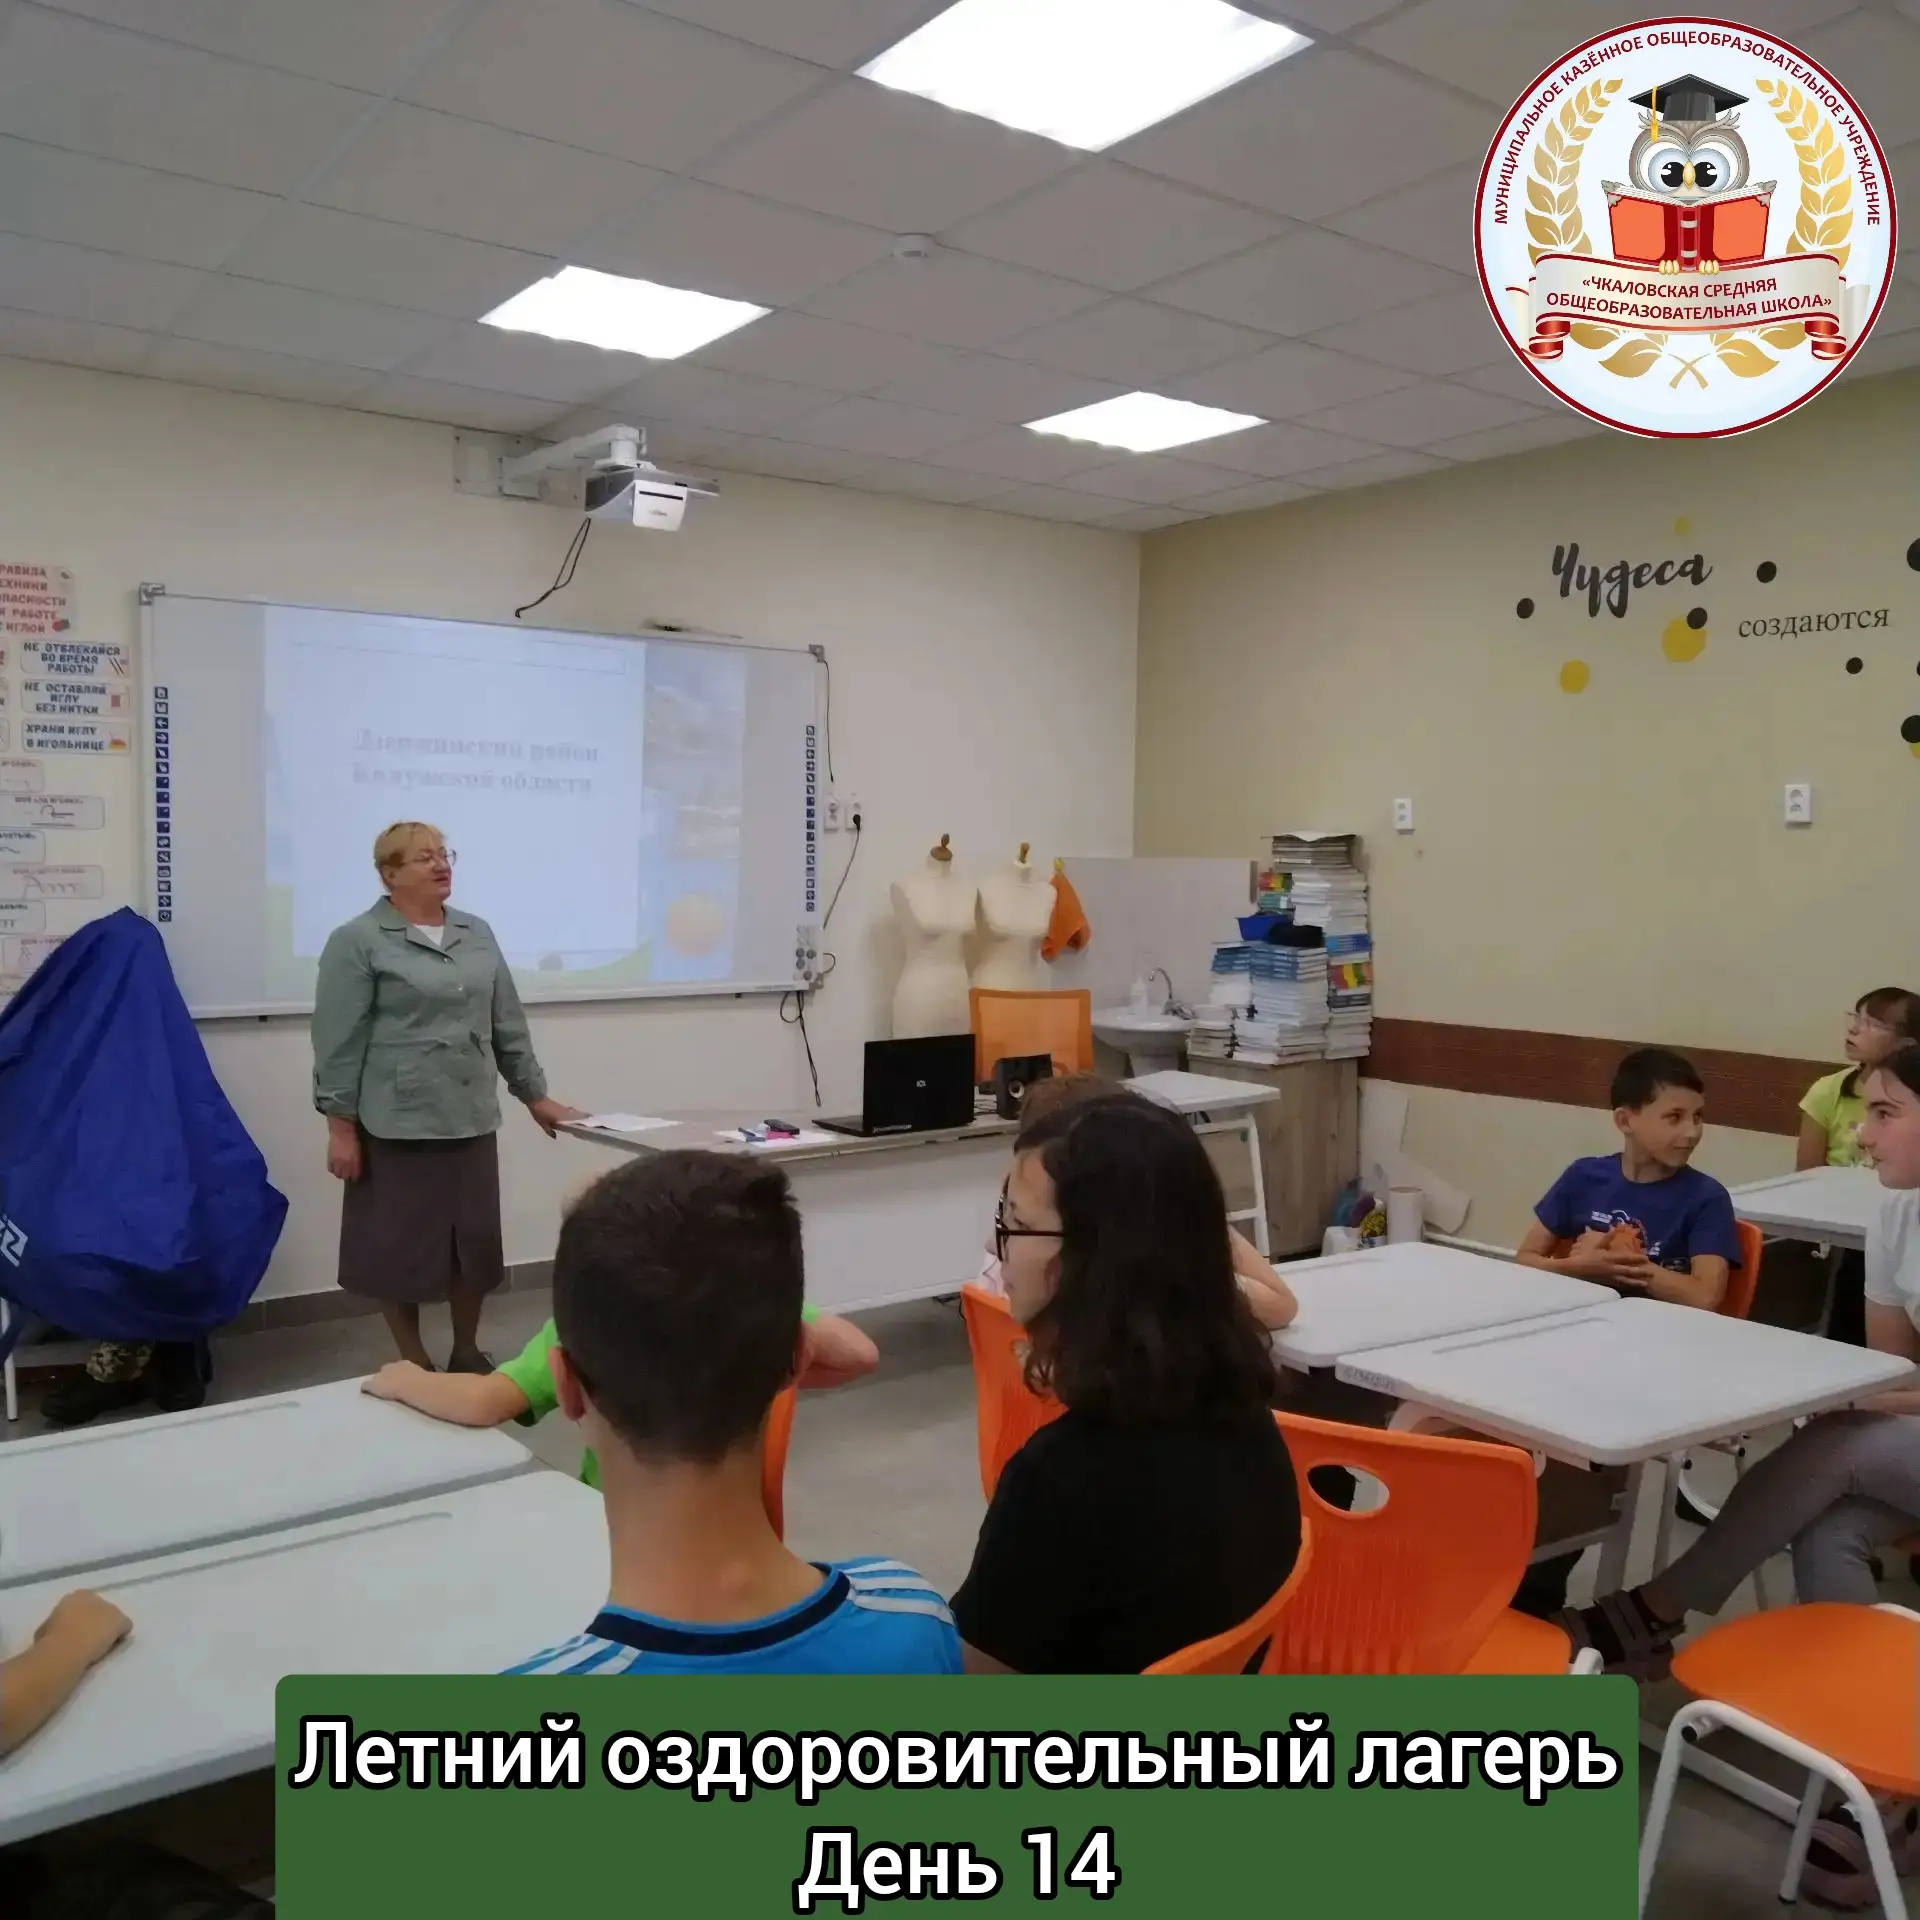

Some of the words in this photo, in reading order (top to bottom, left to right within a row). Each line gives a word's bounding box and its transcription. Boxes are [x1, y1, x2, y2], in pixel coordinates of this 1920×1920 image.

[1551, 542, 1714, 619] Чудеса
[0, 594, 66, 607] ПАСНОСТИ
[1738, 608, 1890, 640] создаются
[23, 642, 40, 652] НЕ
[41, 653, 56, 662] ВО
[59, 654, 99, 665] ВРЕМЯ
[47, 663, 95, 674] РАБОТЫ
[24, 682, 40, 692] НЕ
[35, 703, 57, 713] БЕЗ
[60, 704, 99, 714] НИТКИ
[26, 724, 65, 734] ХРАНИ
[68, 725, 97, 735] ИГЛУ
[26, 739, 34, 748] В
[37, 739, 105, 751] ИГОЛЬНИЦЕ
